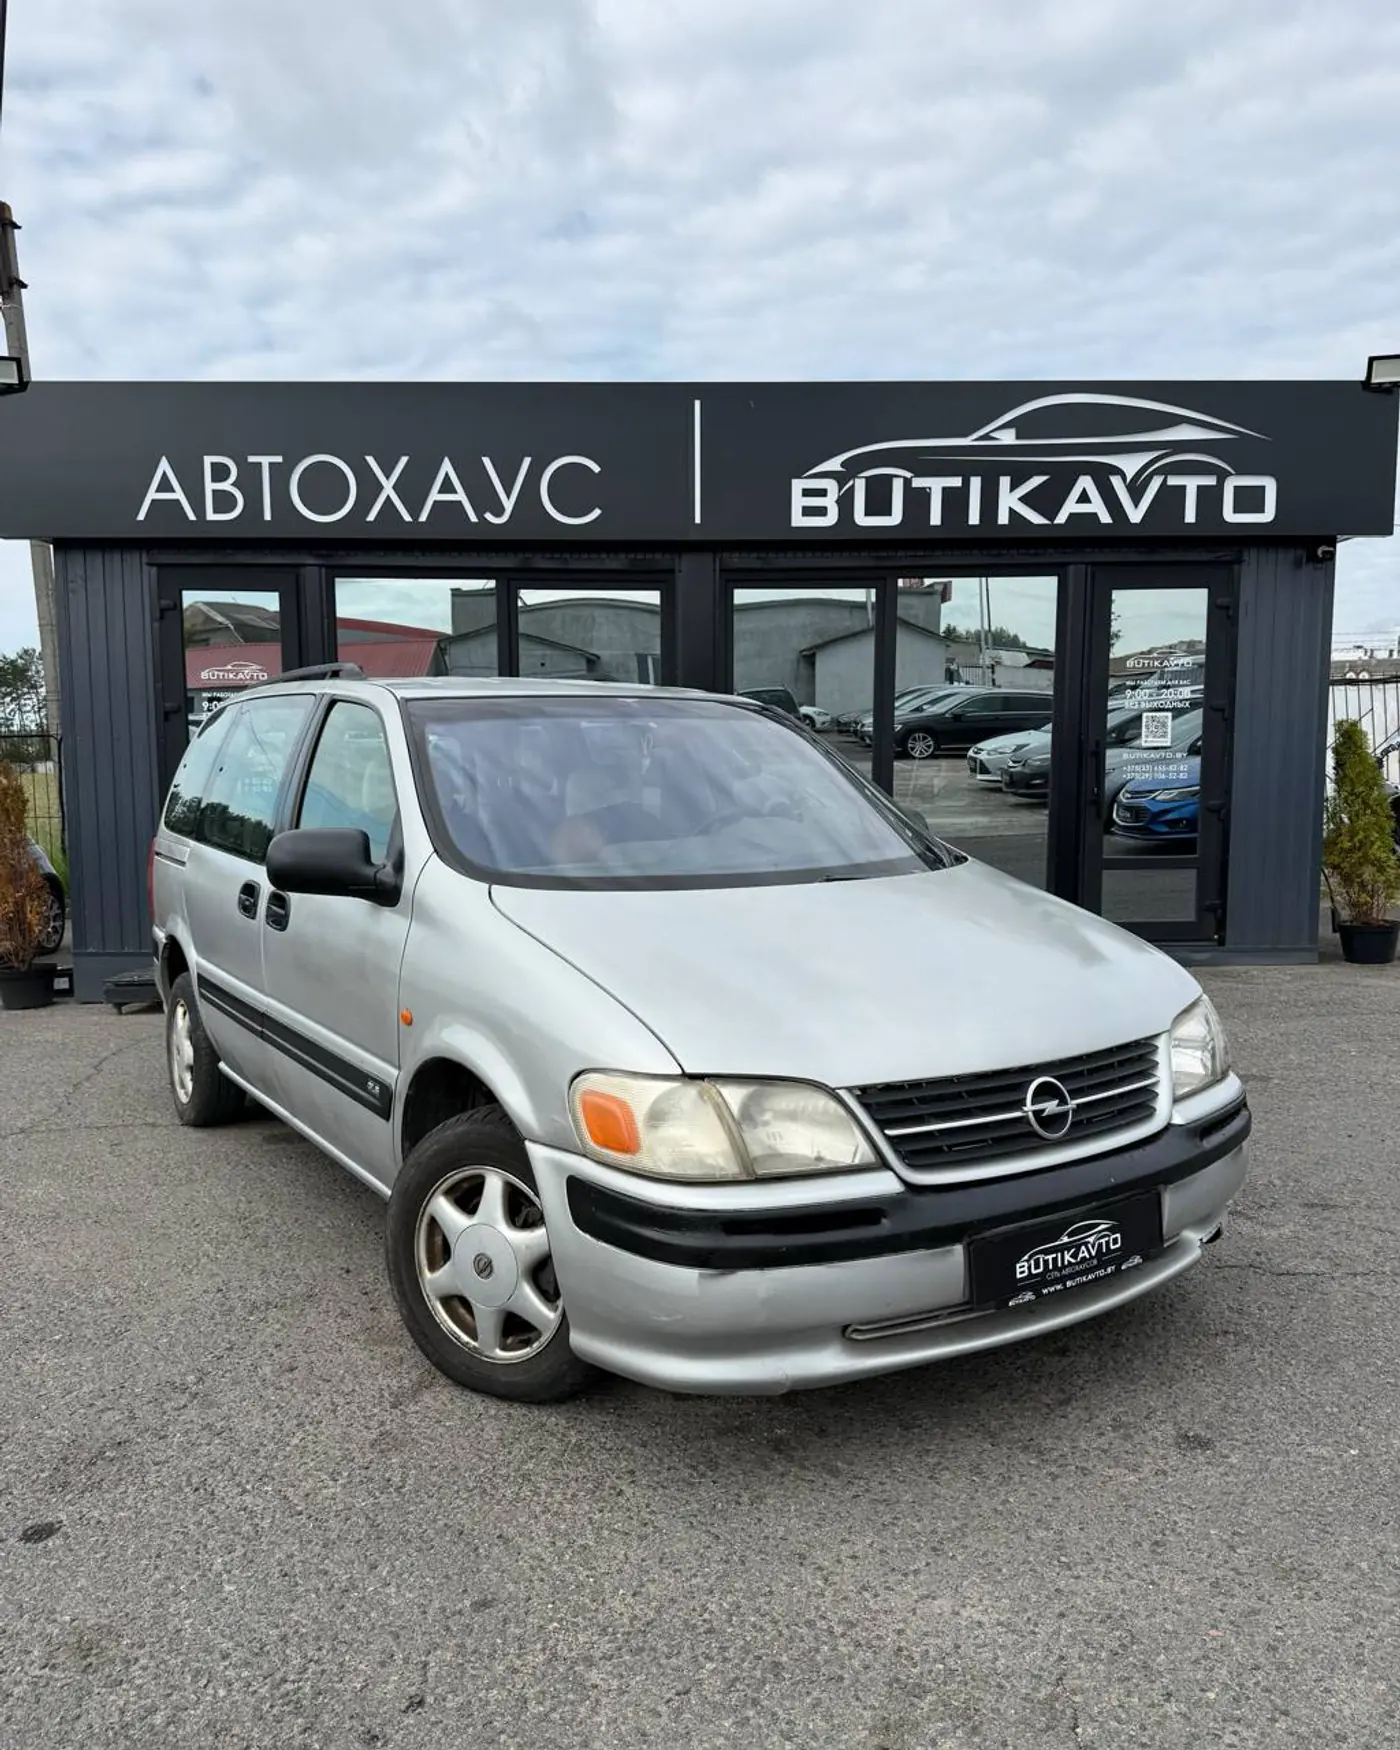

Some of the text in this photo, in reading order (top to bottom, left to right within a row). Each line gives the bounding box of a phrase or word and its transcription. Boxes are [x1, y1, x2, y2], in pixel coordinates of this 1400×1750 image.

[136, 454, 603, 526] АВТОХАУС
[790, 474, 1278, 528] BUTIKAVTO
[1126, 658, 1193, 668] BUTIKAVTO
[200, 671, 268, 681] BUTIKAVTO
[1125, 689, 1149, 700] 9:00
[1160, 689, 1191, 700] 20:00
[1140, 700, 1191, 709] ВЫХОДНЫХ
[1015, 1233, 1122, 1279] BUTIKAVTO
[1066, 1265, 1117, 1289] BUTIKAVTO.BY
